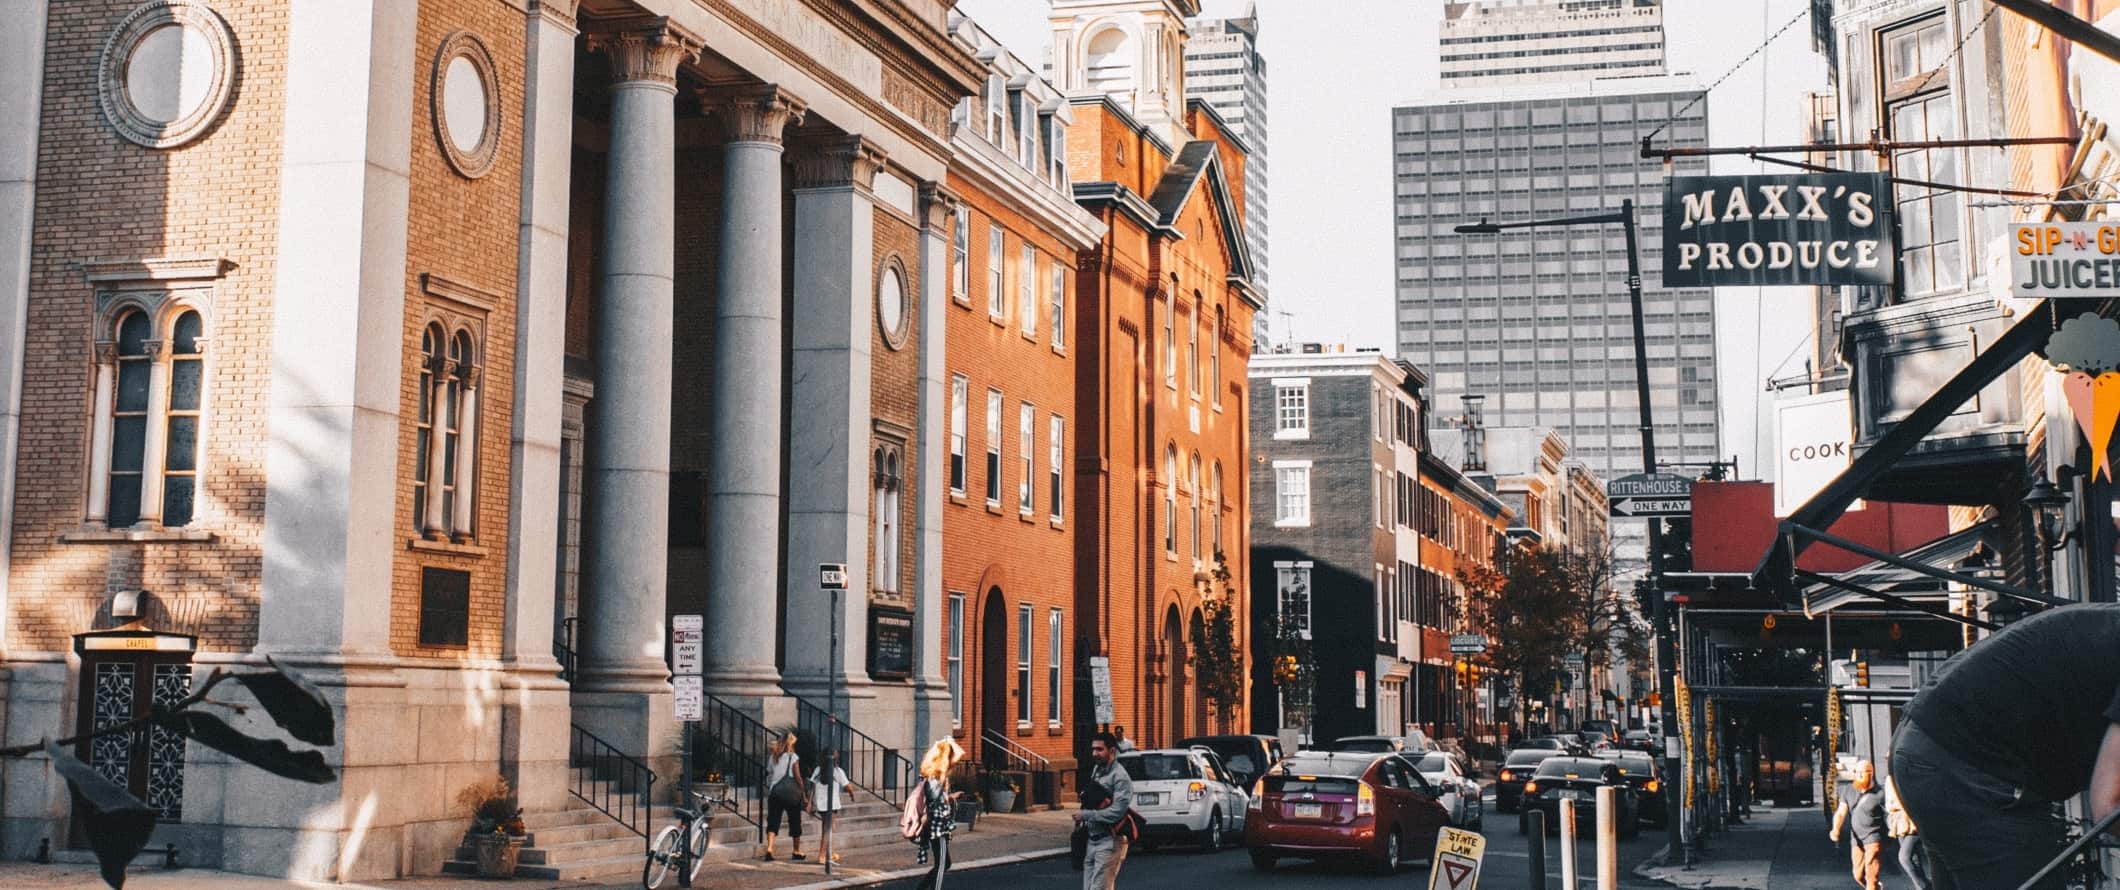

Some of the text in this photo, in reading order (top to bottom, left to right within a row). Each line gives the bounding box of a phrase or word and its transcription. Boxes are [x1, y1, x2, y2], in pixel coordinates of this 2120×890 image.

[1680, 185, 1875, 230] MAXX'S
[1677, 240, 1879, 270] PRODUCE
[1790, 441, 1845, 461] COOK
[1610, 481, 1682, 494] RITTENHOUSE
[1634, 502, 1686, 511] ONE WAY
[126, 640, 148, 648] CHAPEL
[1449, 832, 1478, 847] STATE
[1451, 844, 1471, 855] LAW
